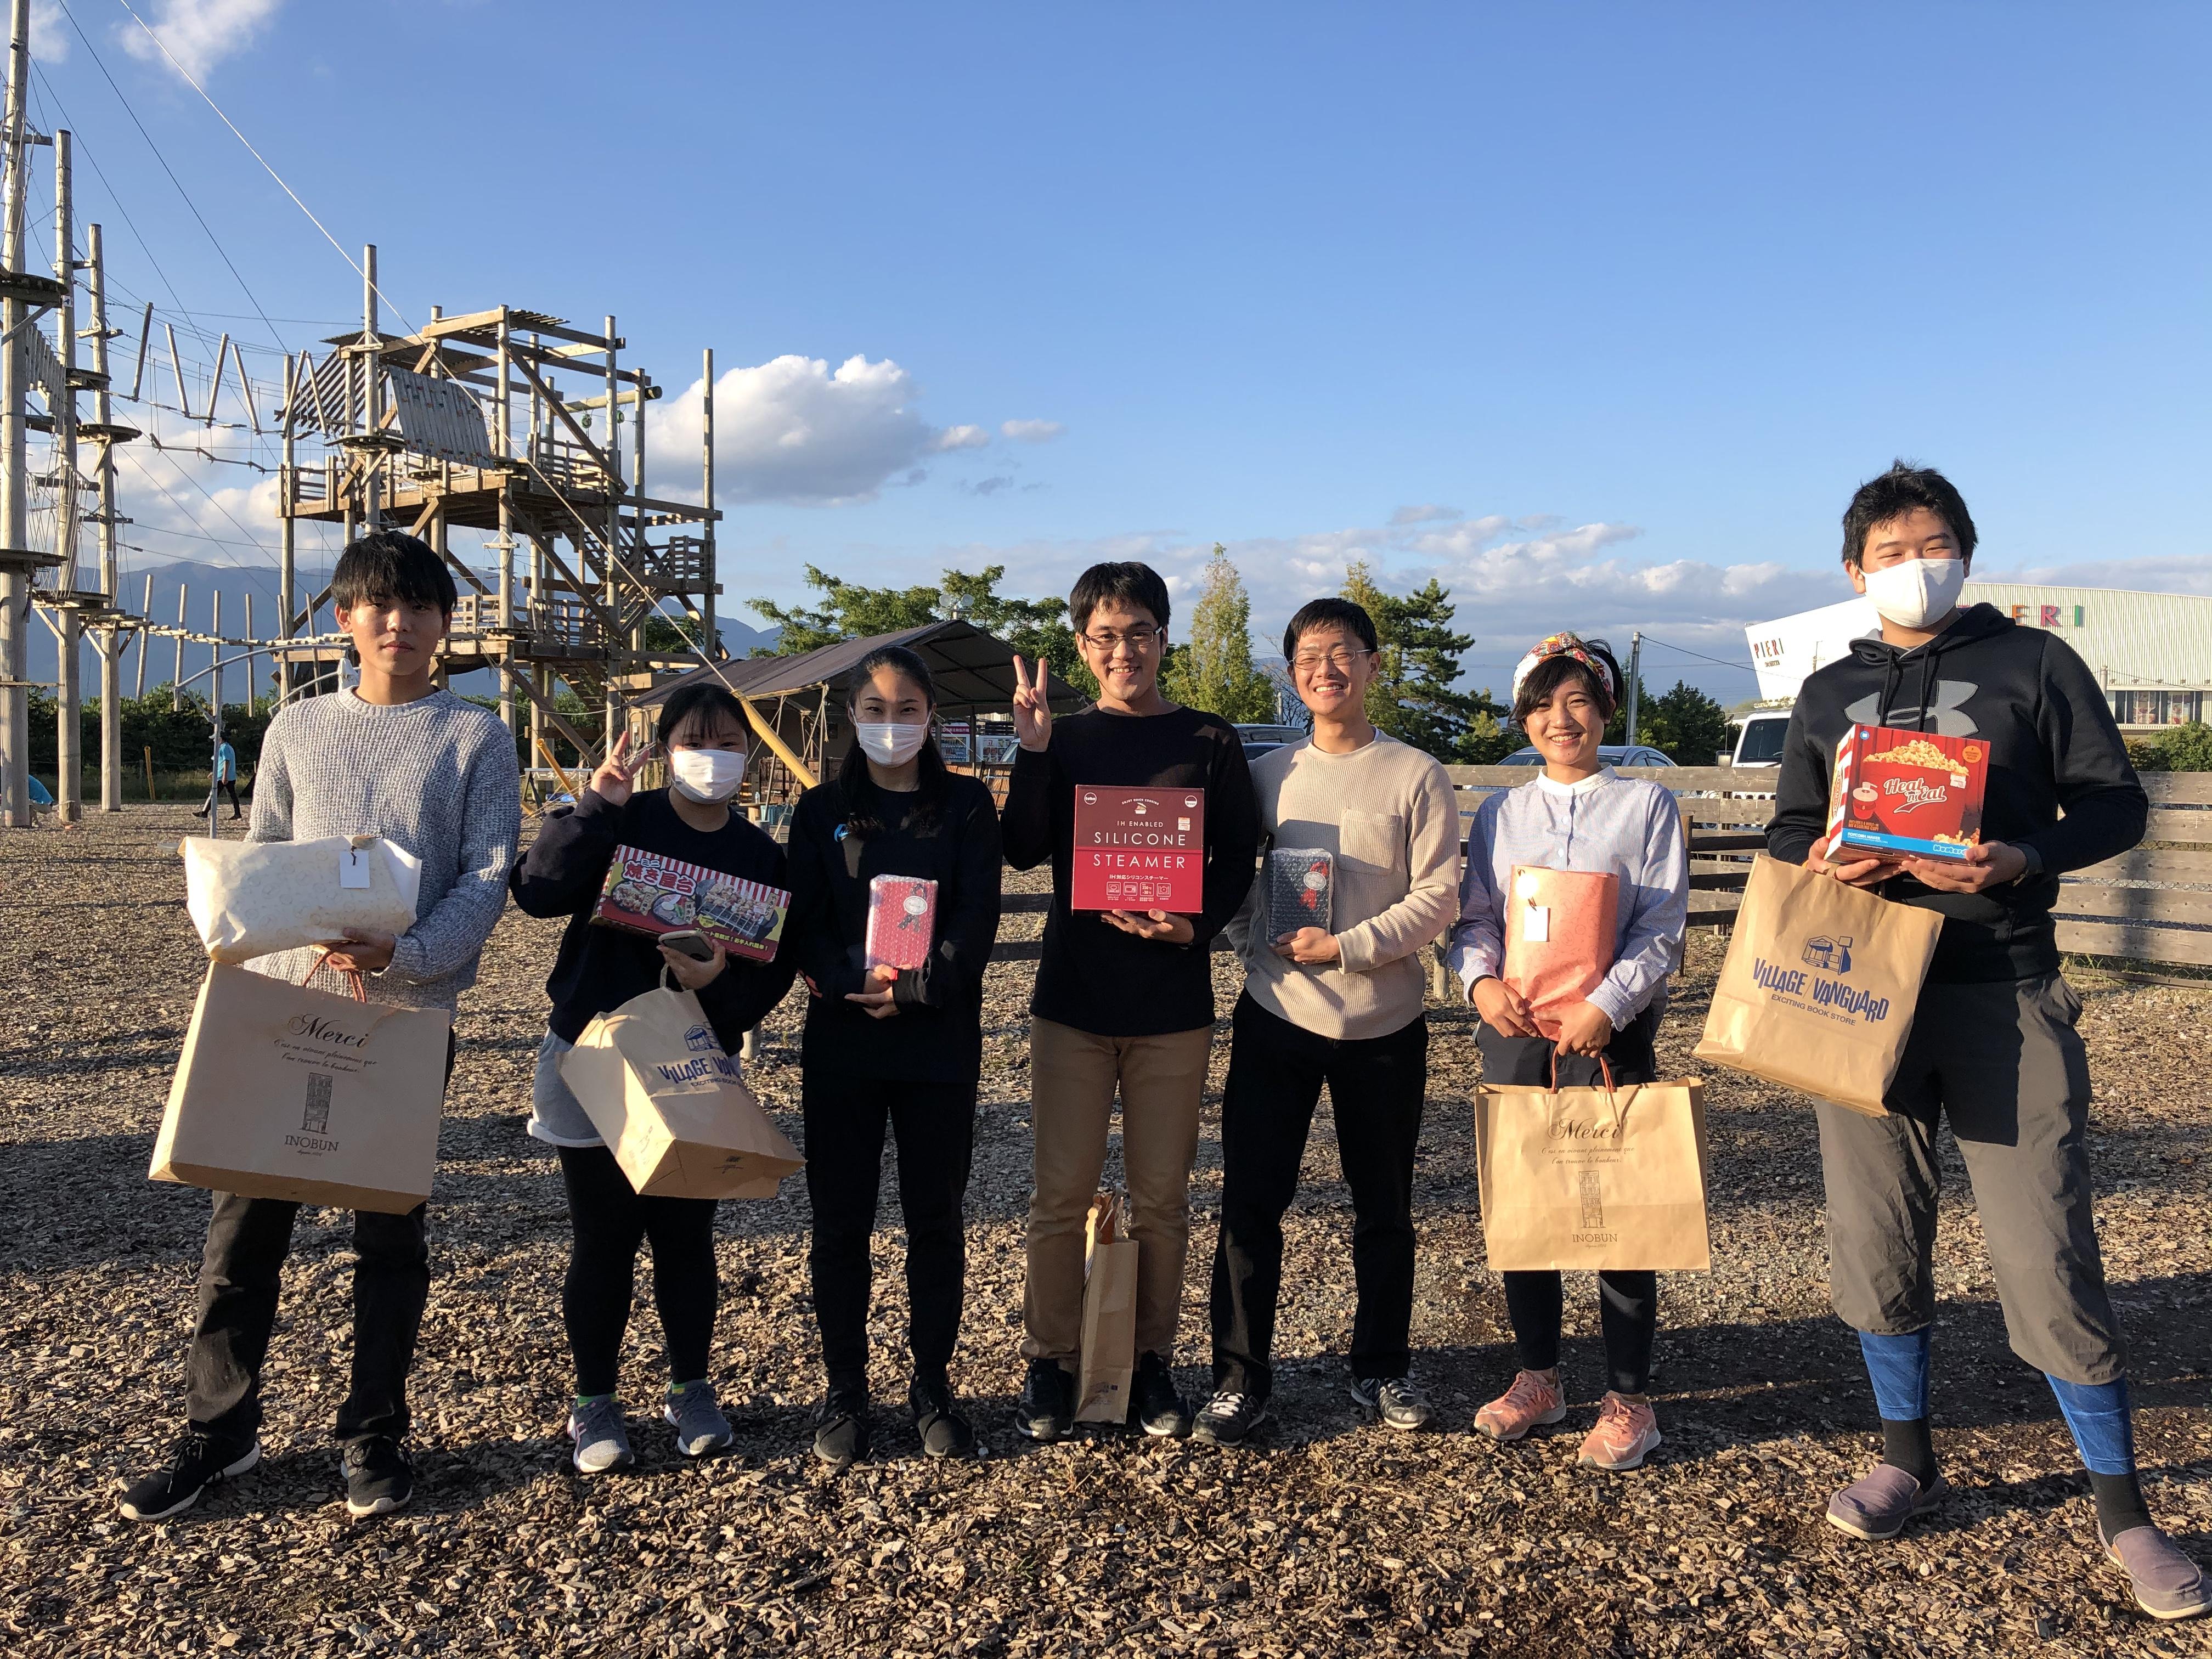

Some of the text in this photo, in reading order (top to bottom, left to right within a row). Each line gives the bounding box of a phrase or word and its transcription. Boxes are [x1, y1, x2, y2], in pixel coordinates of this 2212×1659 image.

[1754, 637, 1784, 658] PIERI
[1883, 777, 1925, 795] Heat
[1918, 785, 1947, 802] Eat
[1094, 832, 1186, 846] SILICONE
[641, 858, 660, 867] ミニ
[1093, 854, 1186, 868] STEAMER
[624, 861, 695, 895] 焼き屋台
[1753, 957, 1889, 1023] VILLAGE VANGUARD
[1771, 994, 1856, 1026] EXCITING BOOK STORE
[288, 1014, 369, 1048] Merci
[657, 1058, 712, 1084] VILLAGE
[1548, 1118, 1622, 1140] Merci
[284, 1135, 339, 1152] INOBUN
[1588, 1146, 1621, 1155] pleinement
[1572, 1233, 1618, 1242] INOBUN
